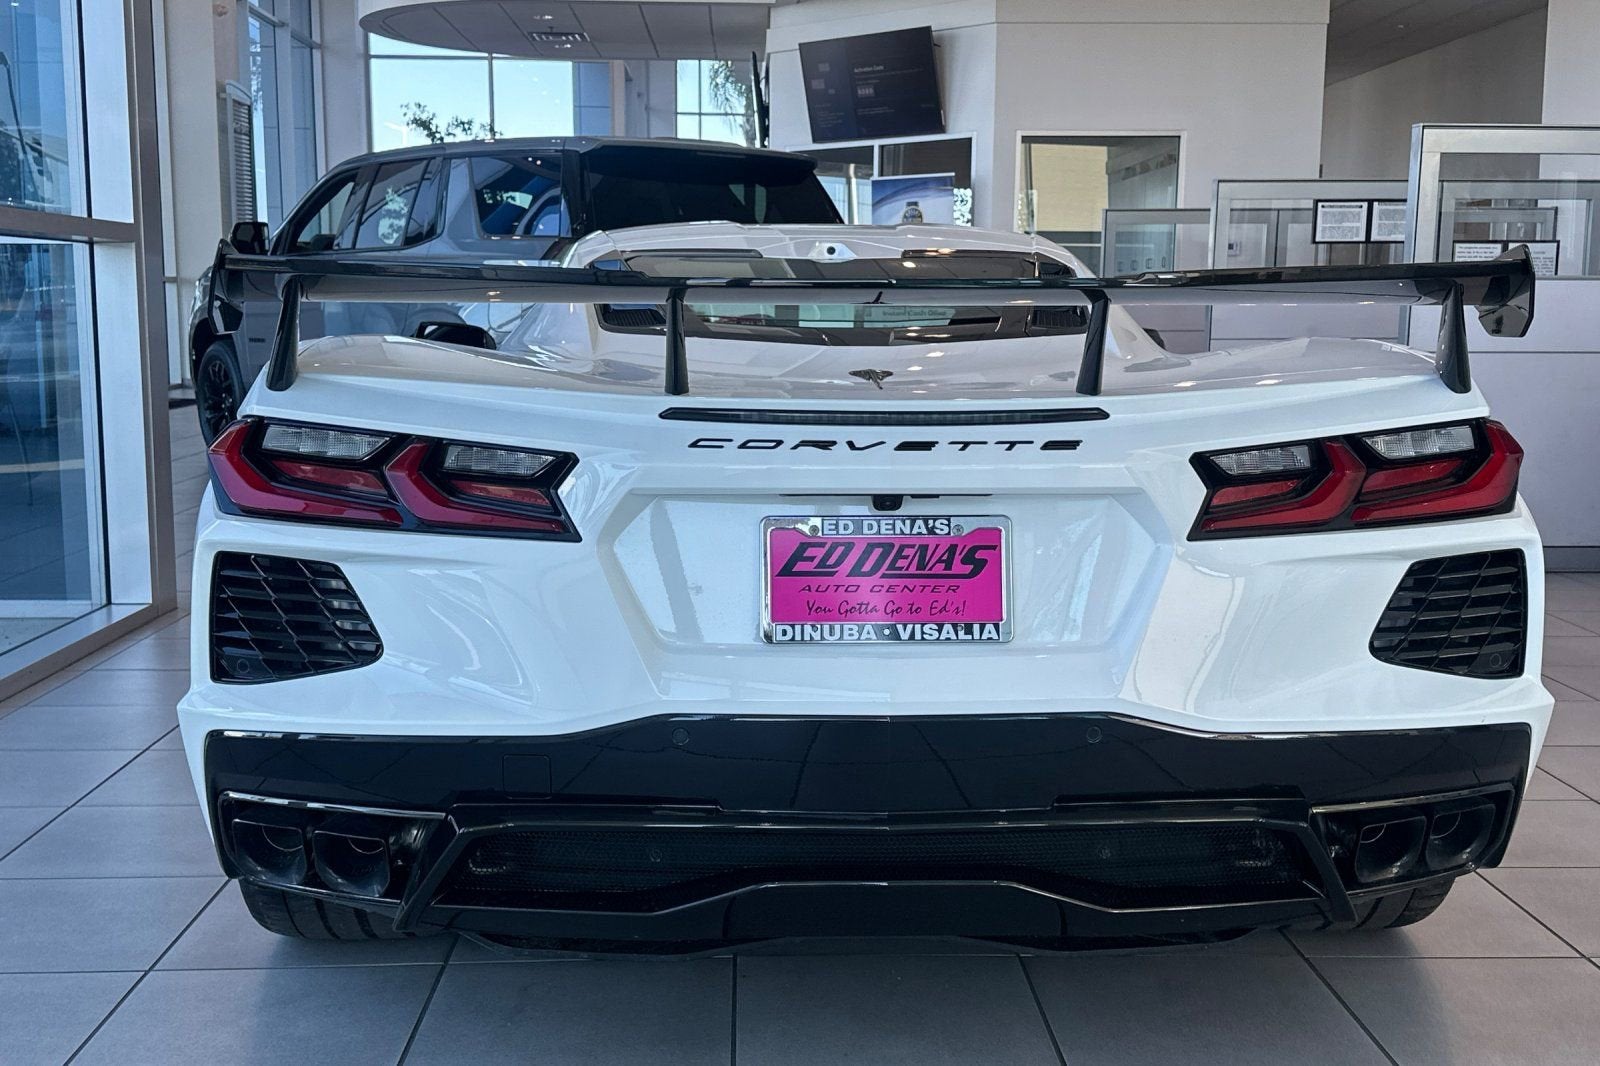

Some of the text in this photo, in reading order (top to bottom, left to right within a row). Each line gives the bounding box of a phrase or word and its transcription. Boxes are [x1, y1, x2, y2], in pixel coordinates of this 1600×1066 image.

[687, 437, 1083, 452] CORVETTE
[823, 519, 950, 536] ED DENA'S
[775, 541, 856, 578] ED
[798, 584, 961, 594] AUTO CENTER
[806, 599, 967, 617] You Gotta Go to Ed's!
[775, 623, 1000, 641] DINUBA VISALIA
